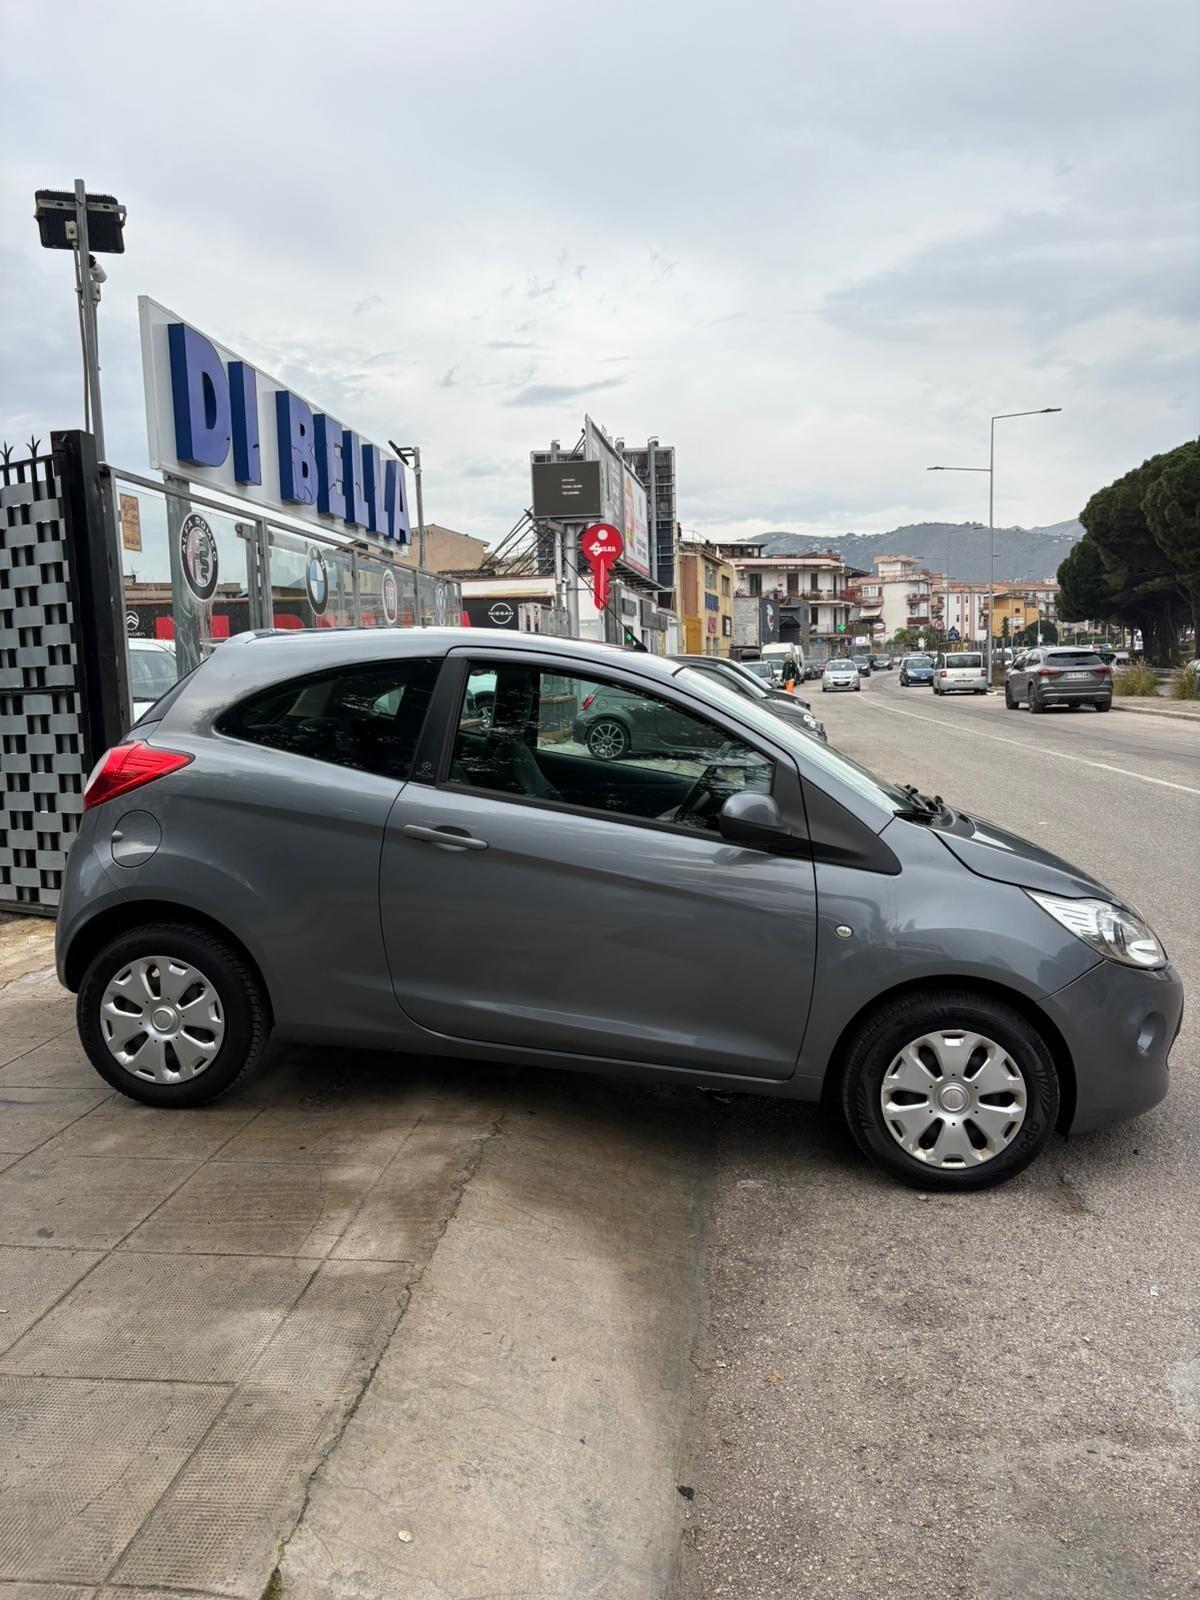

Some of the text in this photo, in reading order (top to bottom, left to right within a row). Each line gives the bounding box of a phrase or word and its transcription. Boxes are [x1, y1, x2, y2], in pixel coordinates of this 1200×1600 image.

[168, 323, 412, 546] DI BELLA
[182, 517, 218, 562] ALFA ROMEO
